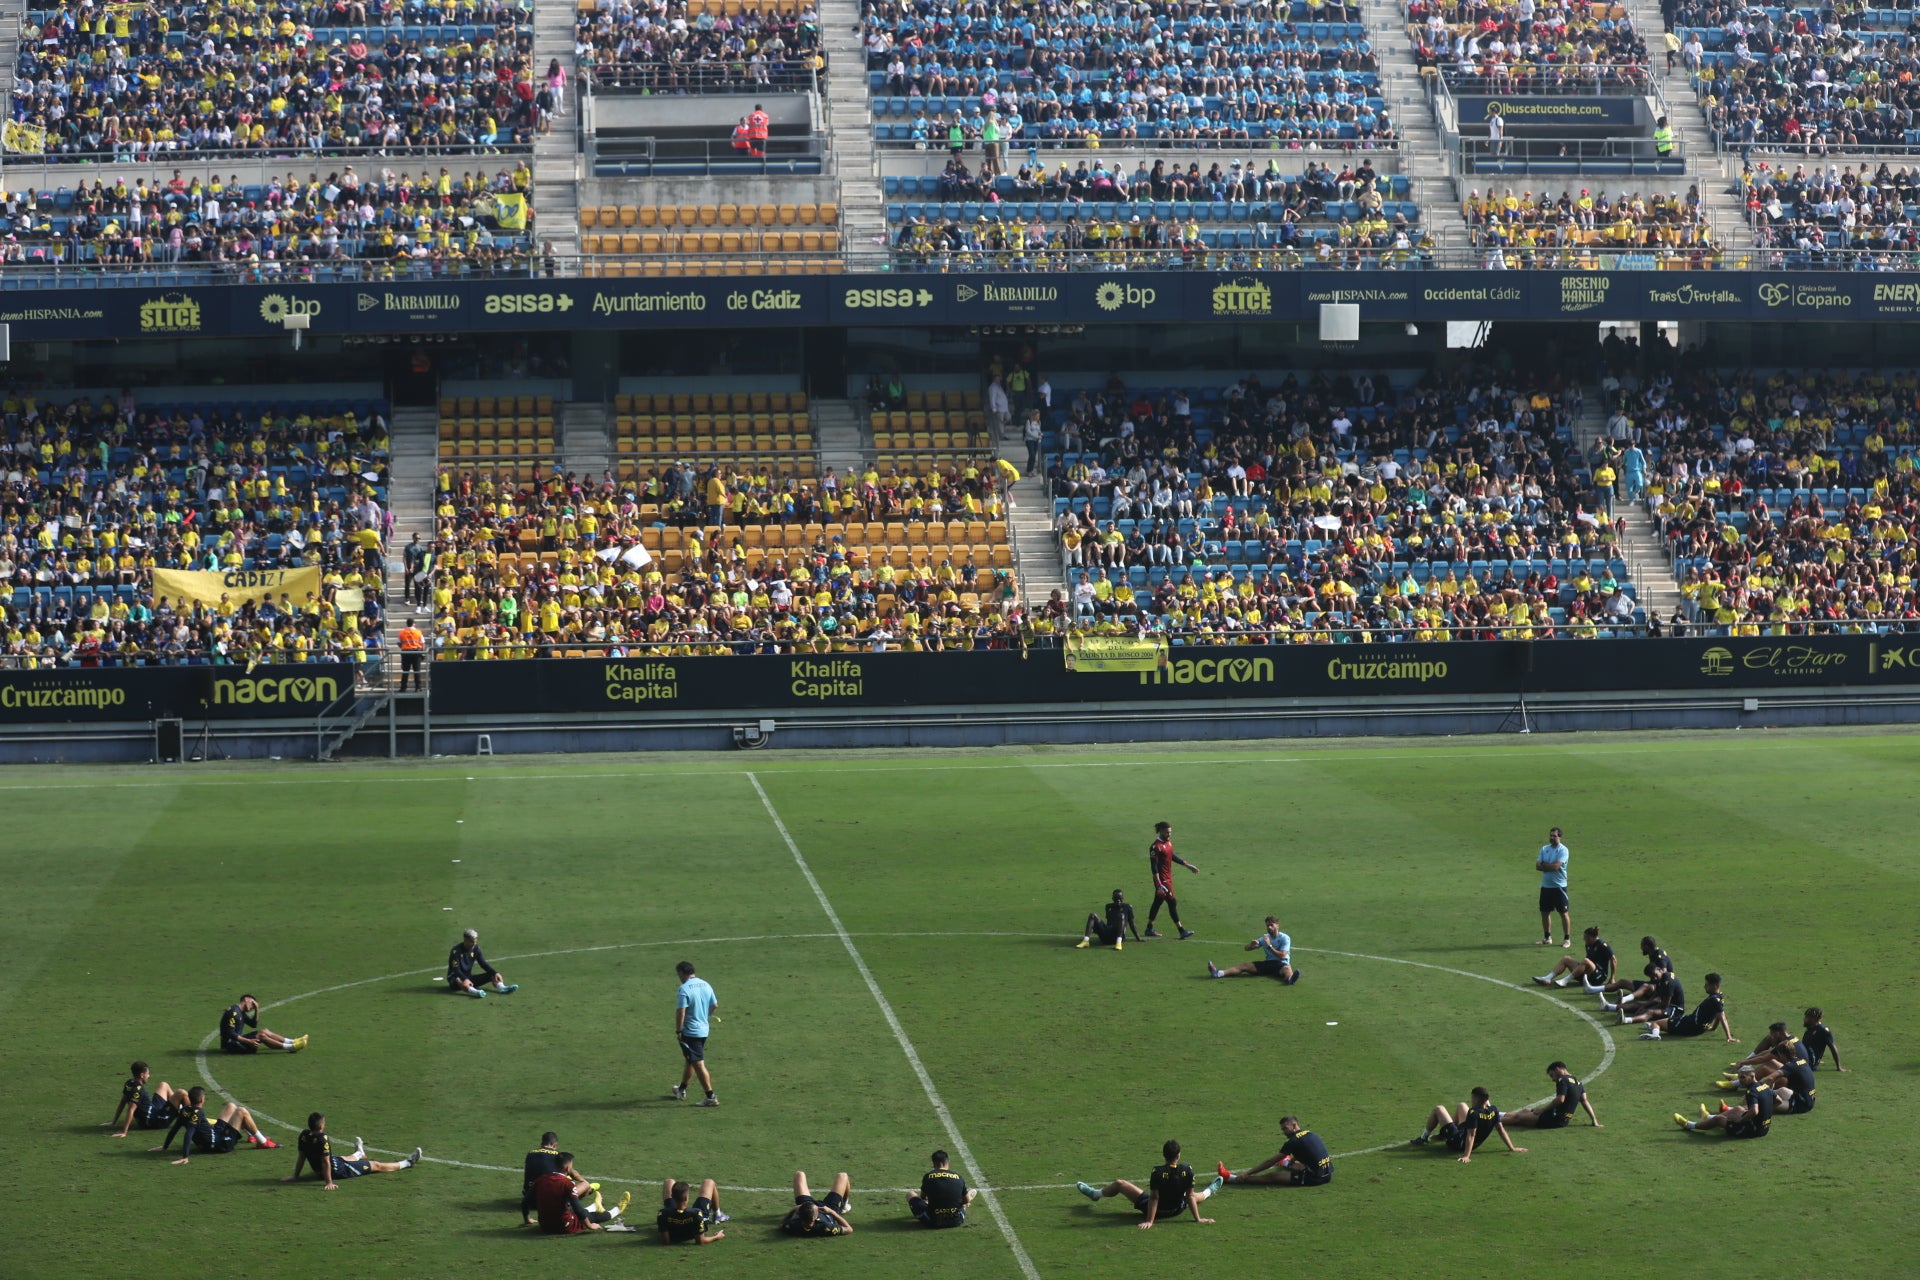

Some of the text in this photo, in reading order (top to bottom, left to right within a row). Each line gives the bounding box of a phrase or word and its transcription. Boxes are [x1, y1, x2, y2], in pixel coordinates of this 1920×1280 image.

[1560, 277, 1610, 289] ARSENIO
[593, 289, 801, 316] Ayuntamiento de Cádiz
[845, 289, 914, 308] asisa
[1126, 283, 1156, 309] bp
[1212, 292, 1272, 310] SLICE
[1424, 286, 1521, 300] Occidental Cádiz
[1561, 290, 1605, 303] MANILA
[1796, 292, 1851, 309] Copano
[291, 295, 321, 316] bp
[484, 294, 554, 313] asisa
[140, 308, 201, 328] SLICE
[1742, 646, 1848, 669] El Faro
[605, 663, 676, 681] Khalifa
[791, 660, 862, 678] Khalifa
[1327, 657, 1448, 682] Cruzcampo
[1, 684, 125, 709] Cruzcampo
[606, 682, 677, 702] Capital
[791, 679, 862, 700] Capital
